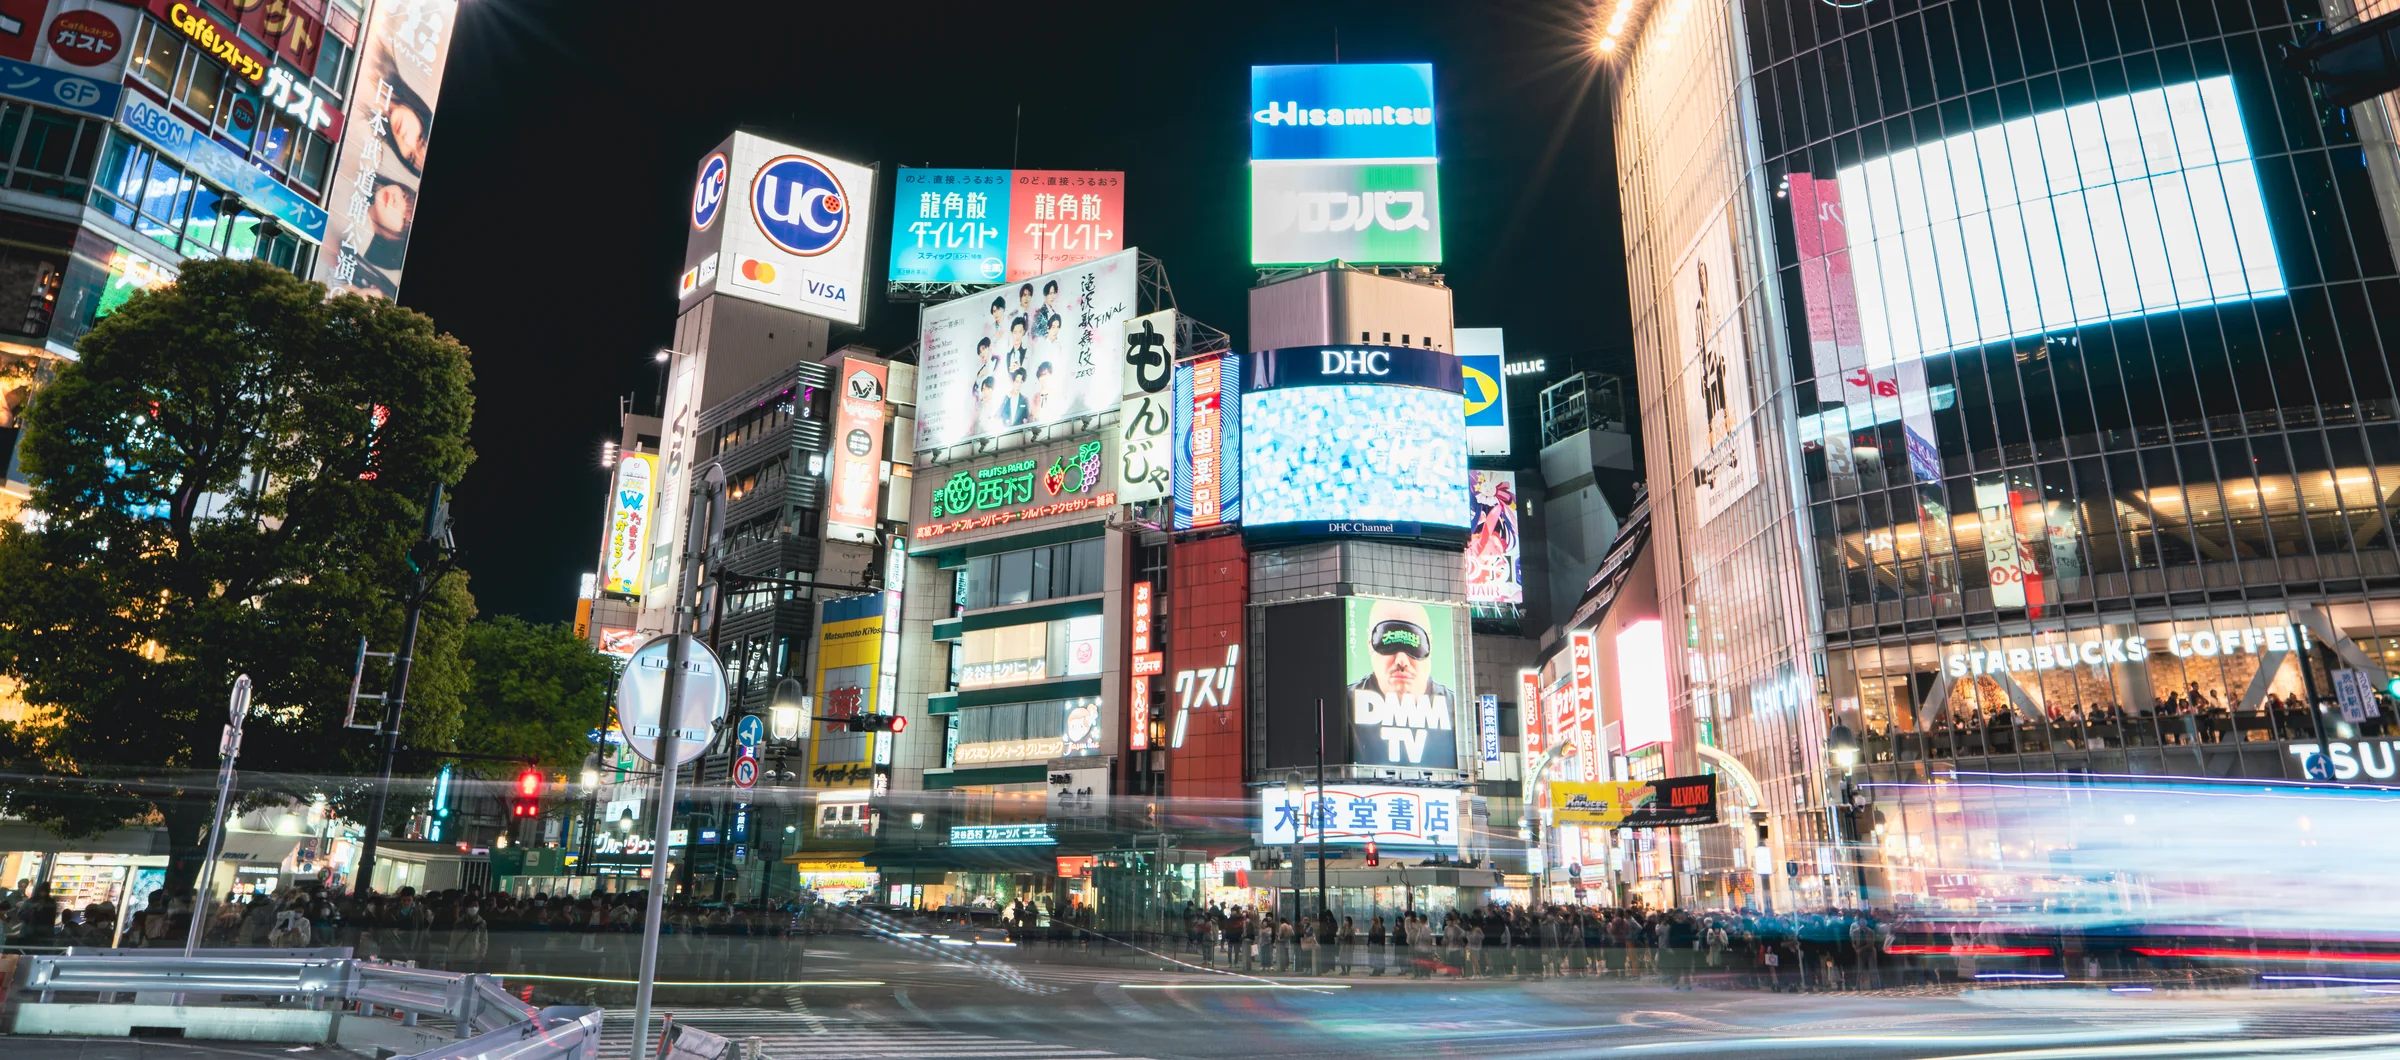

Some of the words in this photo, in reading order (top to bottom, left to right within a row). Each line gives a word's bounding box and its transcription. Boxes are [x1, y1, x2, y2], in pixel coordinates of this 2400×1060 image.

[56, 30, 113, 54] ガスト
[171, 3, 264, 81] Caféレストラン
[59, 82, 96, 103] 6F
[262, 66, 332, 131] ガスト
[131, 102, 185, 146] AEON
[1254, 101, 1431, 126] Hisamitsu
[193, 139, 323, 230] 英会話イーオン
[697, 168, 723, 214] UC
[905, 175, 1005, 185] のど、直接、うるおう
[1019, 176, 1118, 187] のど、直接、うるおう
[763, 174, 838, 234] UC
[920, 191, 988, 219] 龍角散
[1035, 193, 1102, 221] 龍角散
[908, 221, 999, 248] ダイレクト
[1024, 223, 1114, 250] ダイレクト
[917, 252, 952, 260] スティック
[807, 279, 846, 302] VISA
[1094, 302, 1127, 328] FINAL
[1321, 350, 1390, 375] DHC
[1503, 359, 1545, 376] HULIC
[1123, 319, 1172, 494] もんじゃ
[1192, 367, 1215, 516] 三千里薬品
[932, 488, 944, 518] 渋谷
[976, 472, 1035, 510] 西村
[1329, 522, 1352, 532] DHC
[1354, 522, 1394, 533] Channel
[655, 554, 669, 575] 7F
[823, 630, 862, 641] Matsumoto
[1949, 635, 2149, 678] STARBUCKS
[2168, 624, 2312, 658] COFFEE
[1575, 643, 1594, 721] カラオケ
[1354, 689, 1452, 730] DMM
[1380, 727, 1428, 763] TV
[2289, 742, 2400, 780] TSU
[1671, 784, 1709, 807] ALVARK
[1274, 797, 1450, 833] 大盛堂書店
